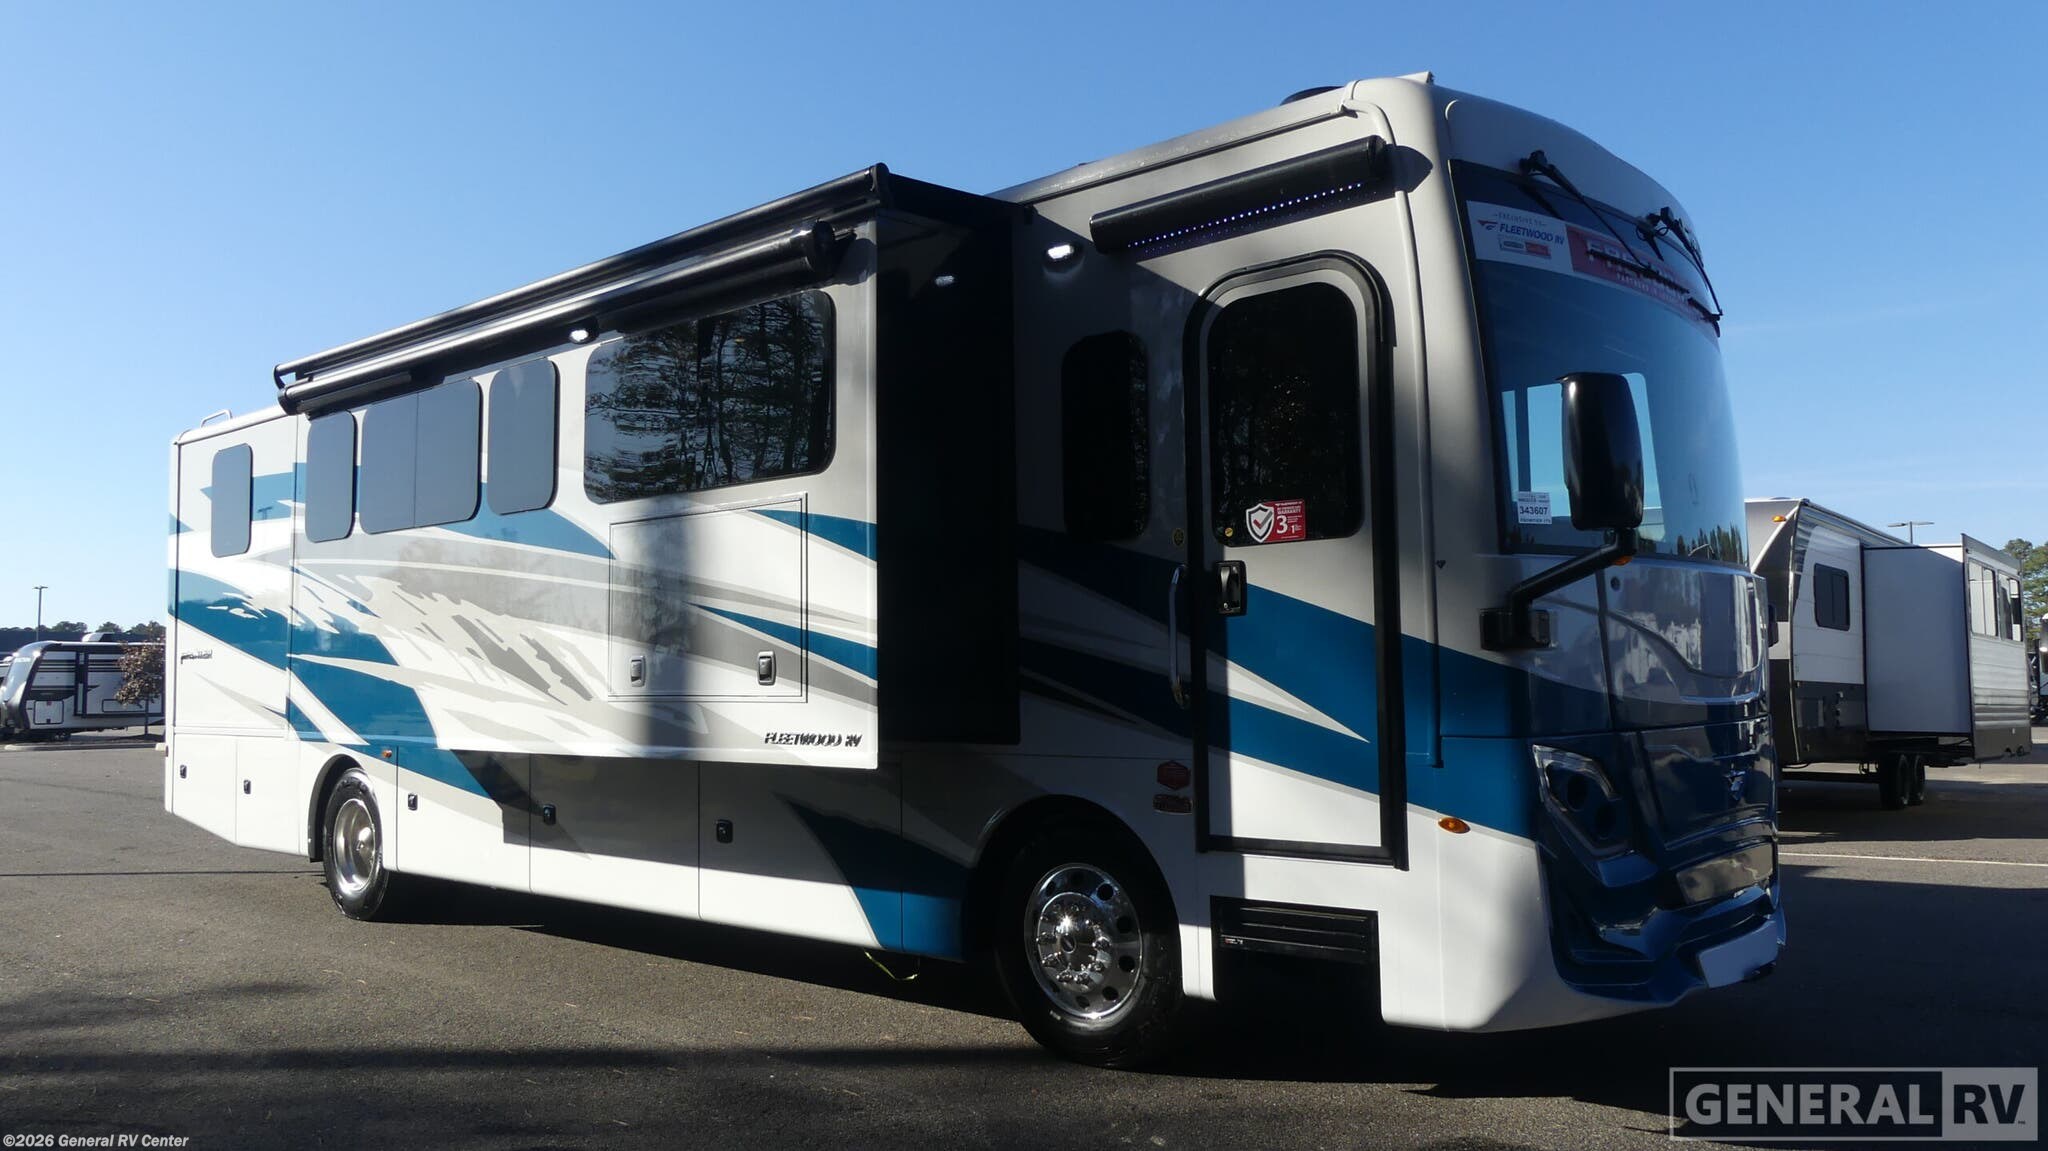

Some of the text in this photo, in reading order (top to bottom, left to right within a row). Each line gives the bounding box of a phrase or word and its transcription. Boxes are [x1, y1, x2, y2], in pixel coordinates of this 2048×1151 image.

[1499, 223, 1565, 245] FLEETWOOD RV
[1519, 506, 1548, 515] 343607
[1276, 515, 1288, 534] 3
[1291, 525, 1295, 534] 1
[764, 732, 862, 747] FLEETWOOD RV
